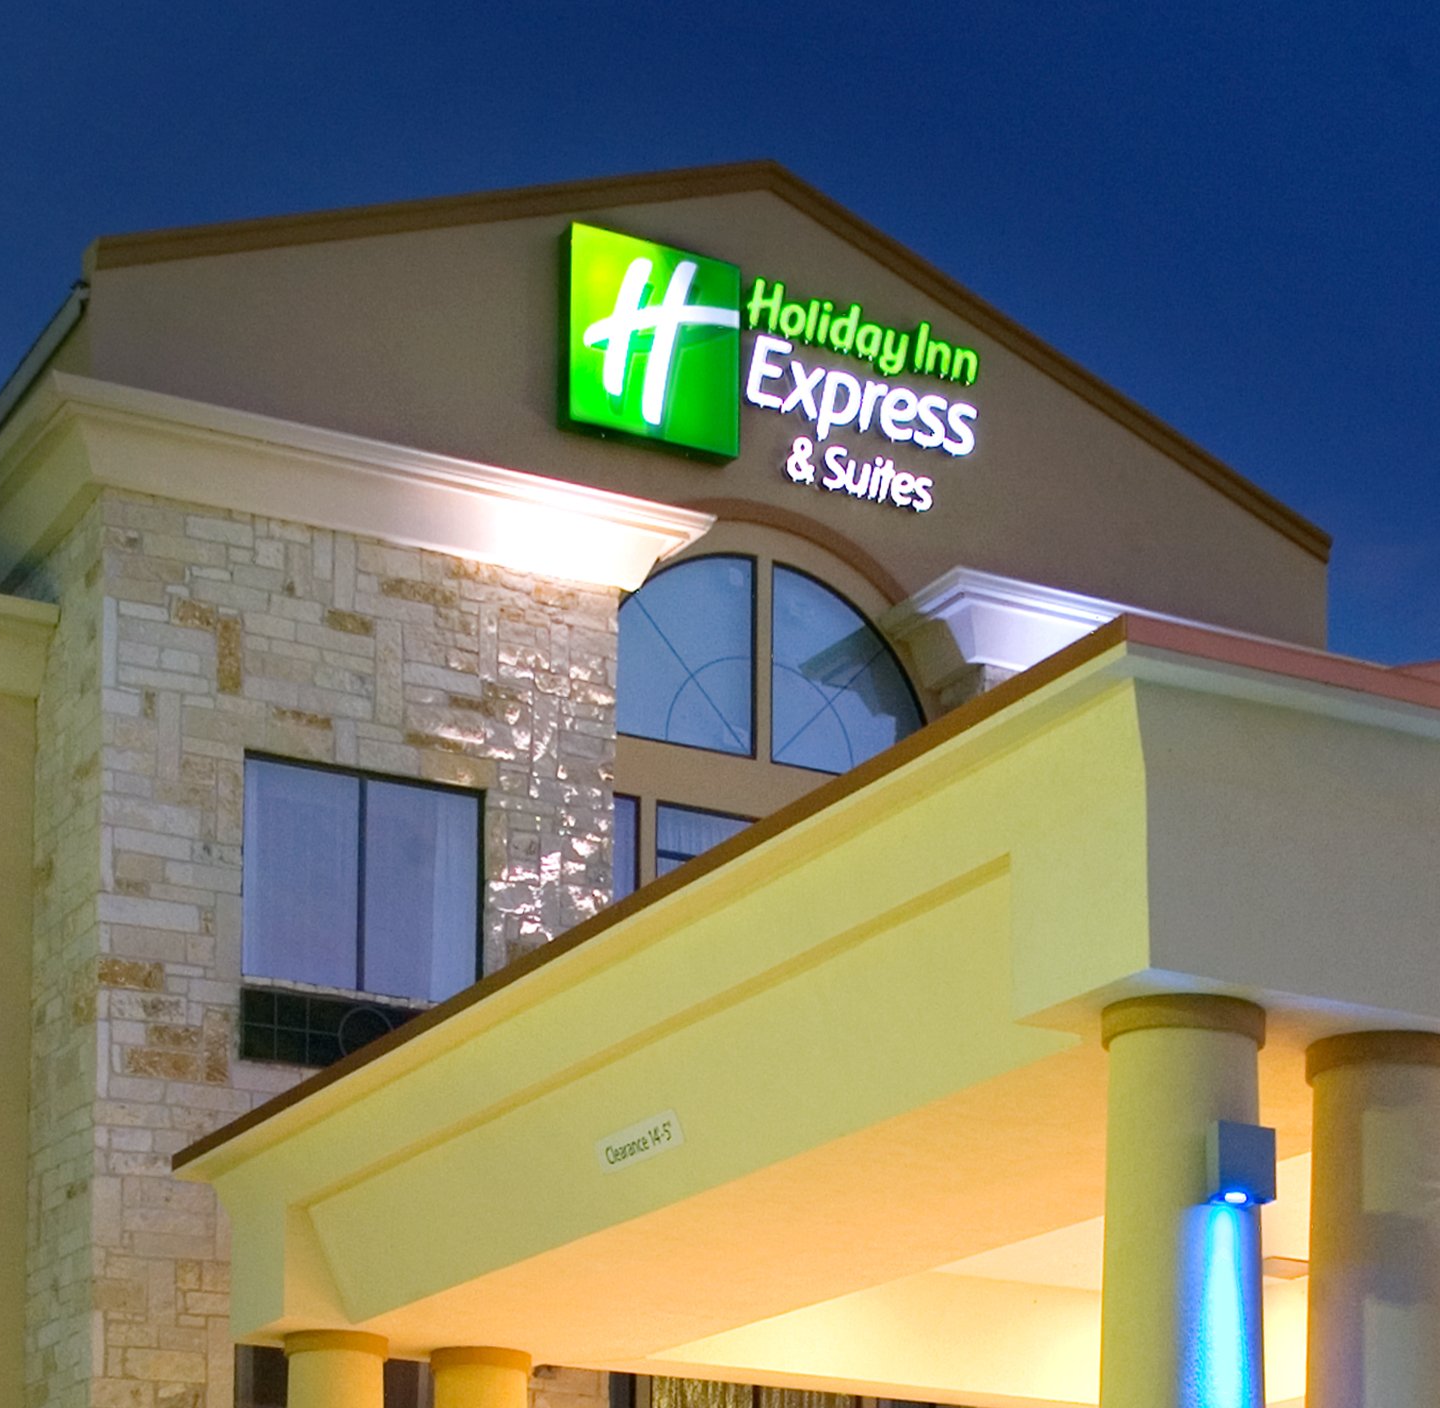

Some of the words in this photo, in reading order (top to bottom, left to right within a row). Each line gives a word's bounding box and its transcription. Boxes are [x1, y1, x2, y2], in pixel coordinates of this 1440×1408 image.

[746, 277, 910, 377] Holiday
[913, 321, 979, 386] Inn
[746, 333, 978, 457] Express
[786, 436, 816, 485] &
[822, 445, 934, 513] Suites
[605, 1136, 650, 1165] Clearance
